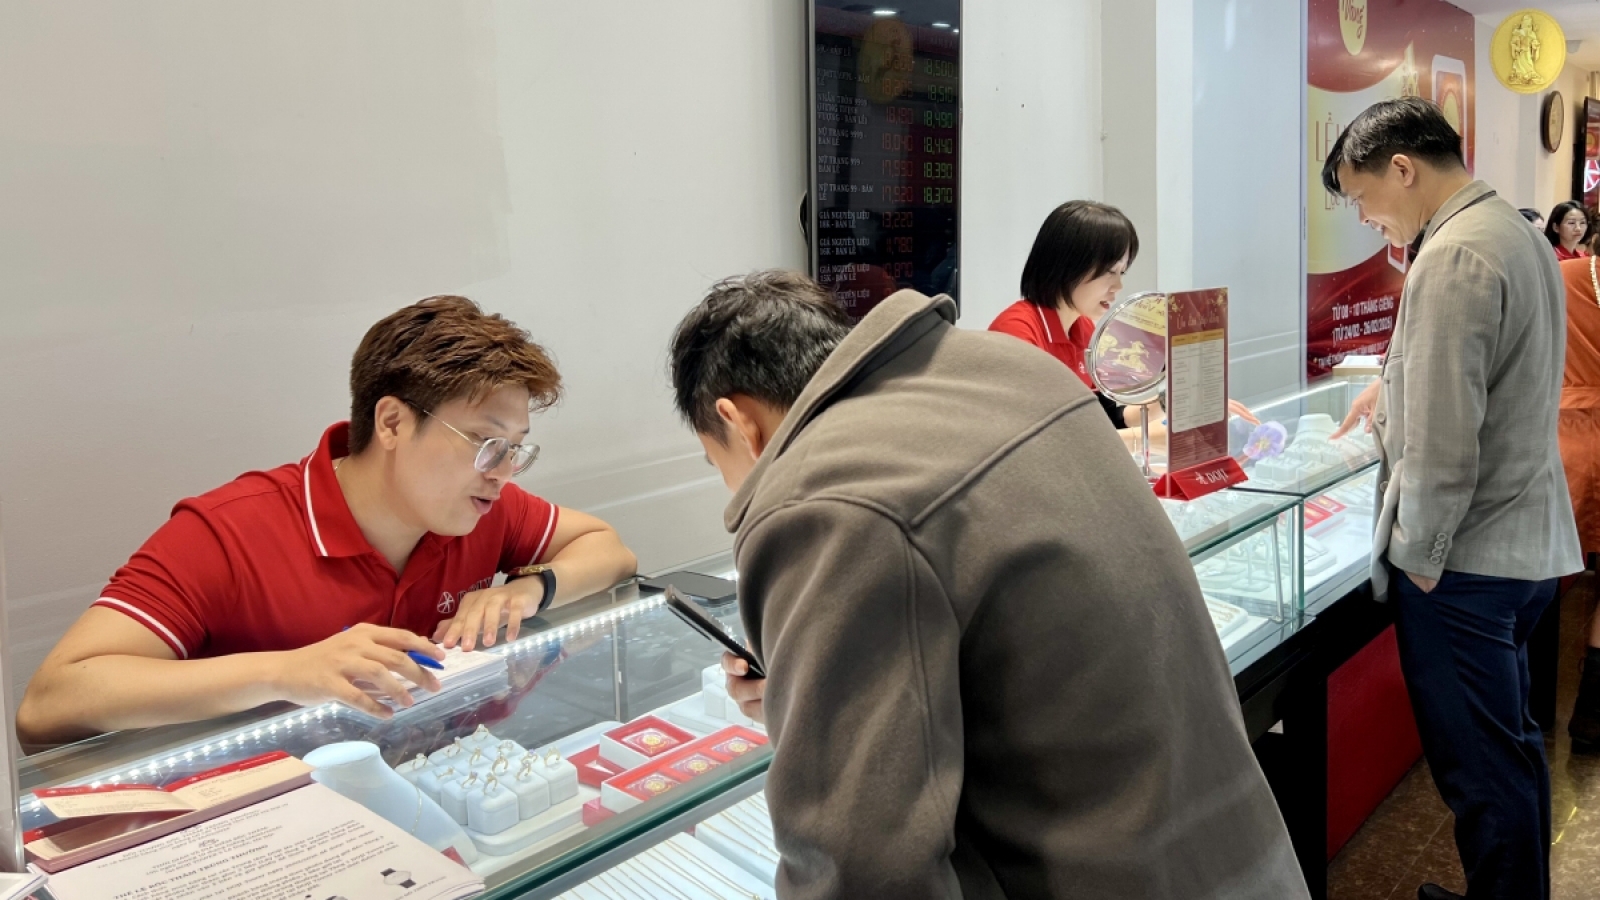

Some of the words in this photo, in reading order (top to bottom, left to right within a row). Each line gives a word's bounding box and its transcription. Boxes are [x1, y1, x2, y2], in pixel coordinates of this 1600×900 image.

[923, 162, 953, 180] 18,390
[923, 187, 953, 205] 18,370
[882, 211, 913, 229] 13,220
[1360, 297, 1378, 315] THÁNG
[1378, 294, 1394, 312] GIÊNG
